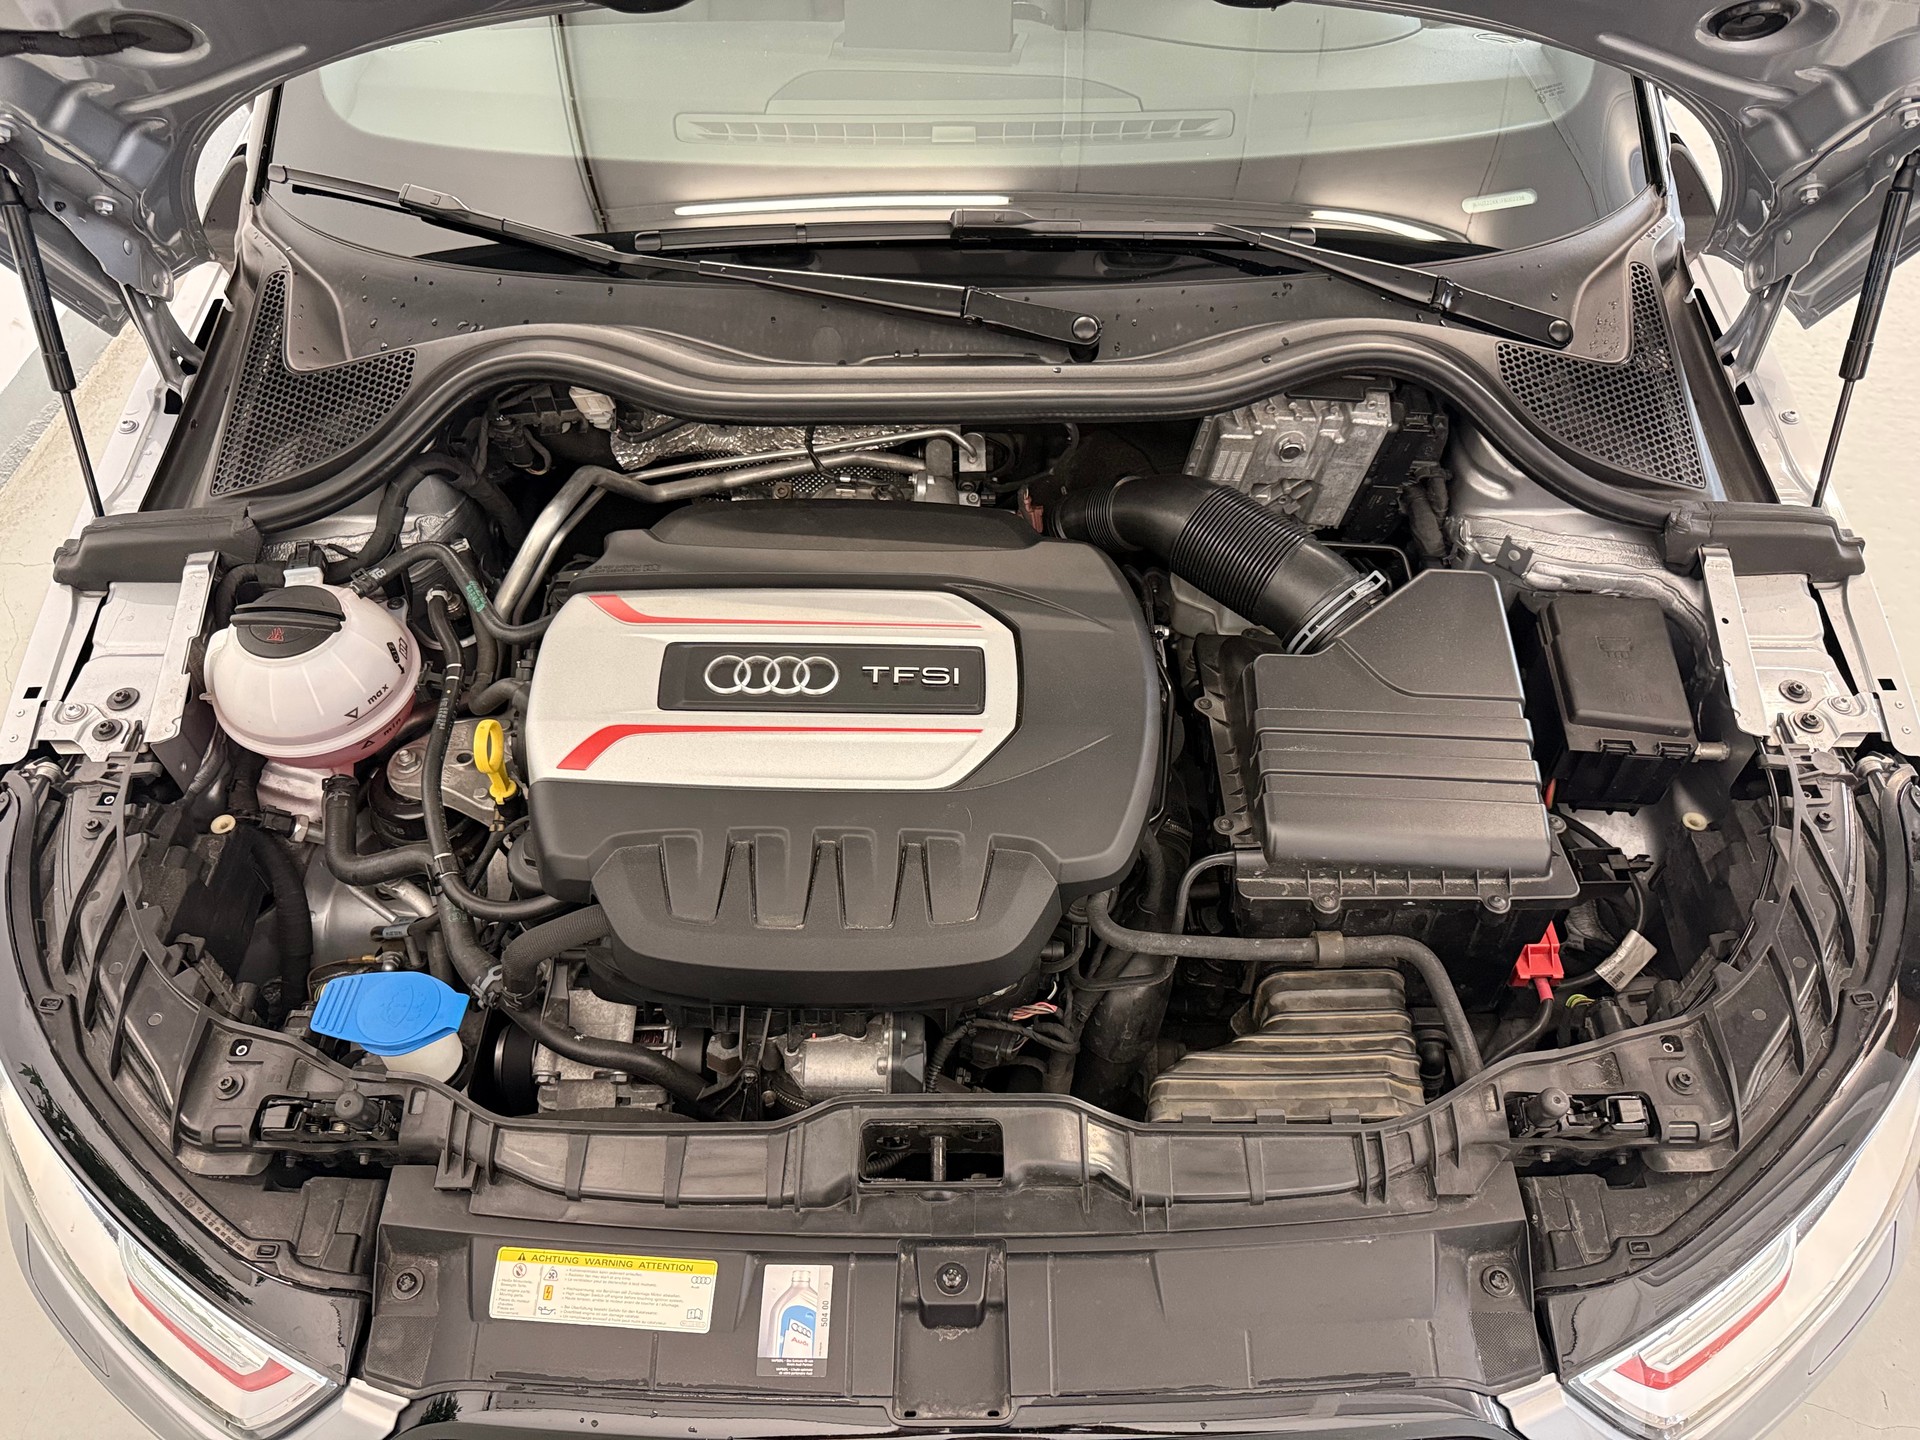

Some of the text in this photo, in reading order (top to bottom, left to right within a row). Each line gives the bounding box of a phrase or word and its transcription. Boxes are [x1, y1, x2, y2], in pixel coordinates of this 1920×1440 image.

[862, 665, 960, 686] TFSI
[367, 683, 389, 705] max
[382, 717, 402, 736] min
[531, 1254, 694, 1272] ACHTUNG WARNING ATTENTION
[820, 1300, 829, 1327] 504 00
